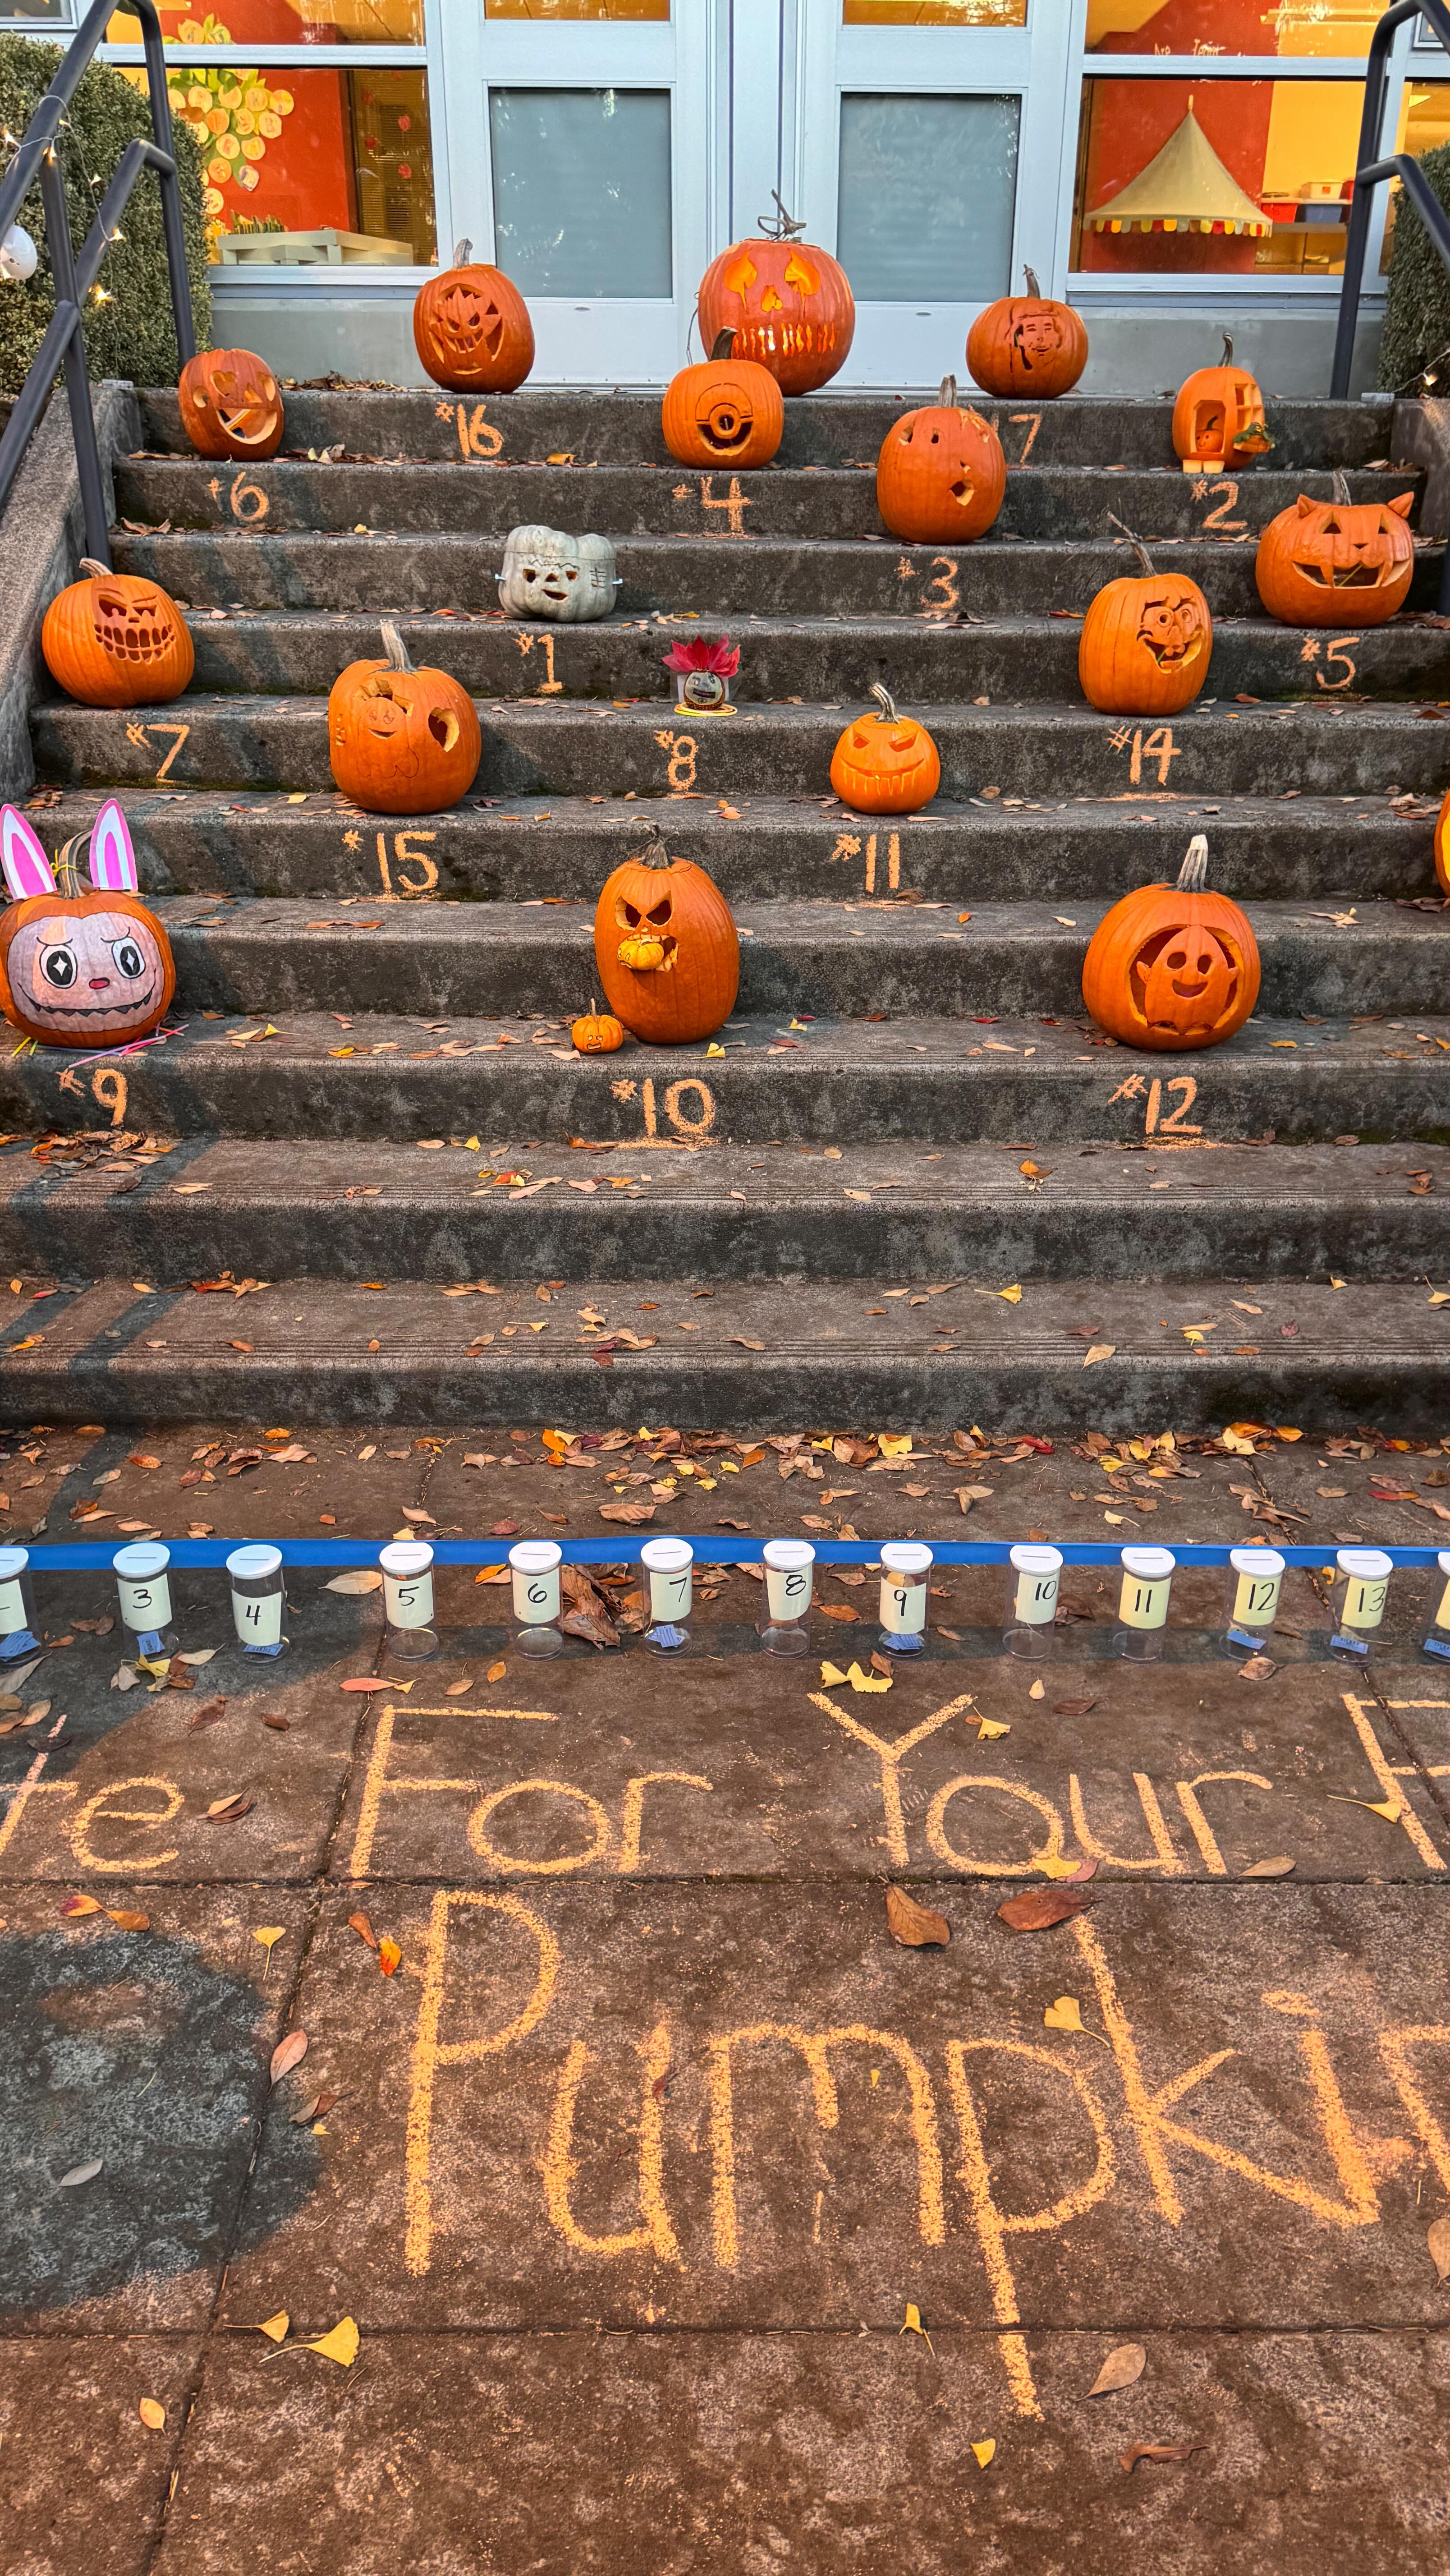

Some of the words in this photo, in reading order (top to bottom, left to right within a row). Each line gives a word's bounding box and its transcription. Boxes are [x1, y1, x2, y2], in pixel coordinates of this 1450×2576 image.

[435, 402, 504, 456] #16
[207, 472, 268, 520] #6
[671, 476, 752, 534] #4
[1193, 480, 1246, 530] #2
[894, 556, 959, 610] #3
[514, 633, 562, 693] #1
[1301, 637, 1358, 688] #5
[126, 722, 190, 782] #7
[653, 730, 699, 790] #8
[1107, 727, 1180, 785] #14
[342, 830, 438, 892] #15
[831, 833, 899, 893] #11
[58, 1068, 127, 1125] #9
[609, 1077, 716, 1137] #10
[1109, 1074, 1202, 1134] #12
[133, 1589, 151, 1608] 3
[399, 1587, 418, 1605] 5
[528, 1583, 546, 1602] 6
[669, 1577, 687, 1602] 7
[785, 1574, 806, 1596] 8
[894, 1590, 906, 1616] 9
[1035, 1580, 1056, 1601] 10
[1135, 1590, 1151, 1612] 11
[1248, 1582, 1277, 1611] 12
[1358, 1586, 1386, 1613] 13
[246, 1605, 260, 1625] 4
[349, 1705, 714, 1877] For
[807, 1693, 1272, 1875] Your
